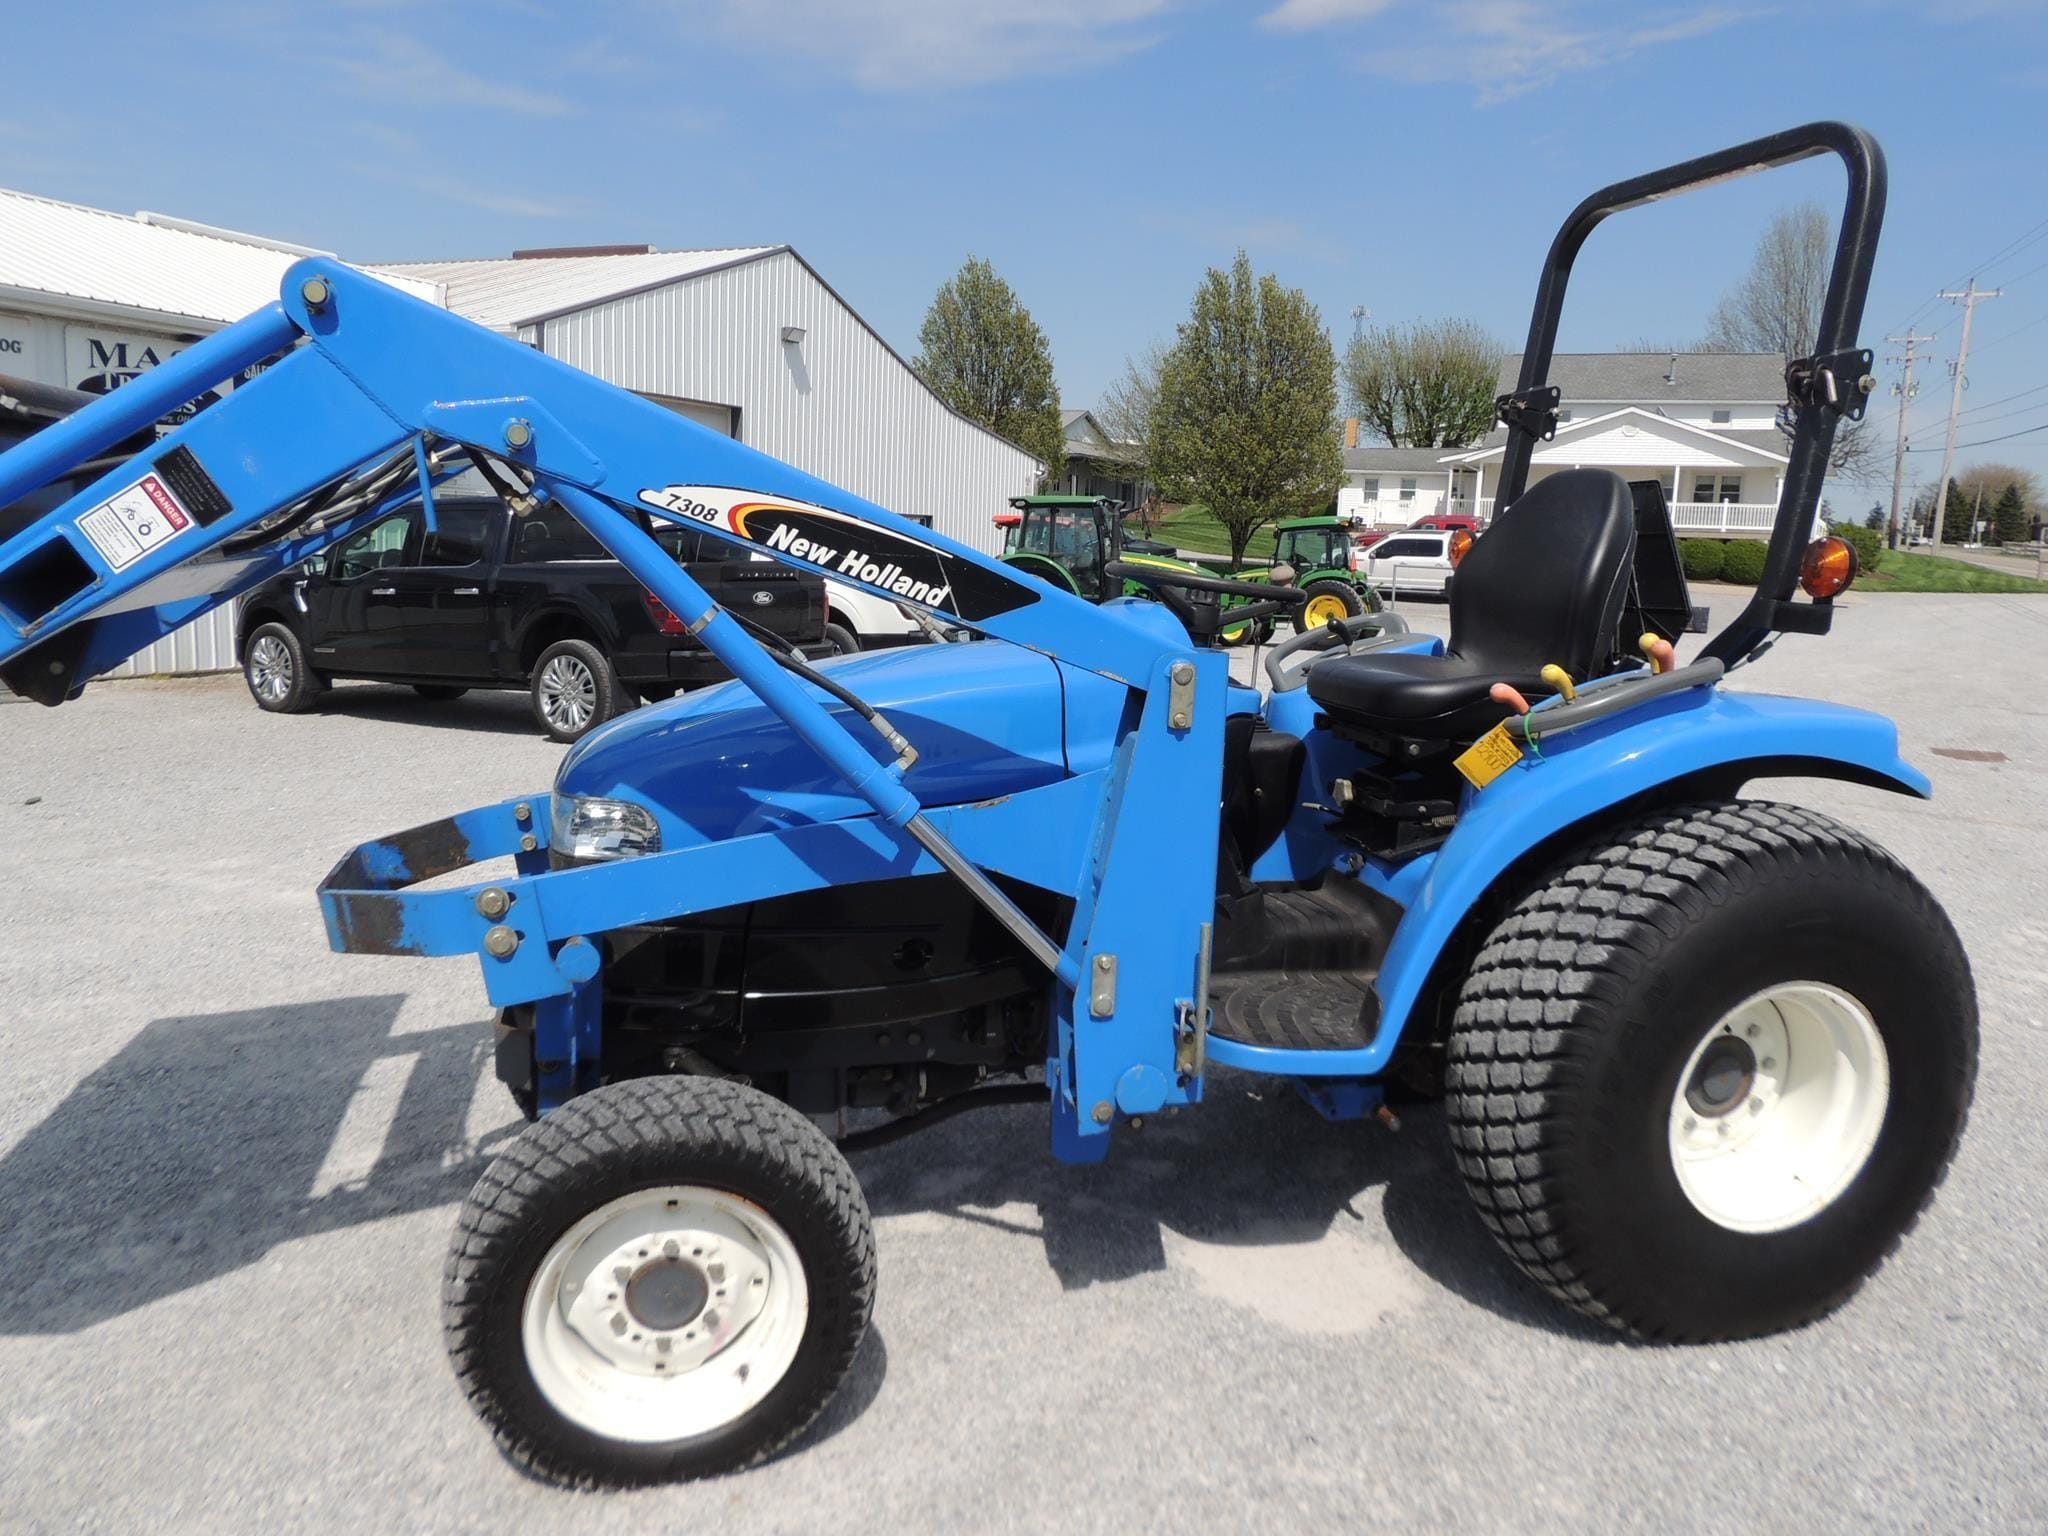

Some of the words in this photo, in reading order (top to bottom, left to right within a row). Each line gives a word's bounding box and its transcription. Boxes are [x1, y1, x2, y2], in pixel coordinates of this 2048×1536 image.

[153, 489, 184, 526] DANGER
[665, 493, 719, 522] 7308
[766, 523, 838, 566] New
[837, 550, 951, 607] Holland
